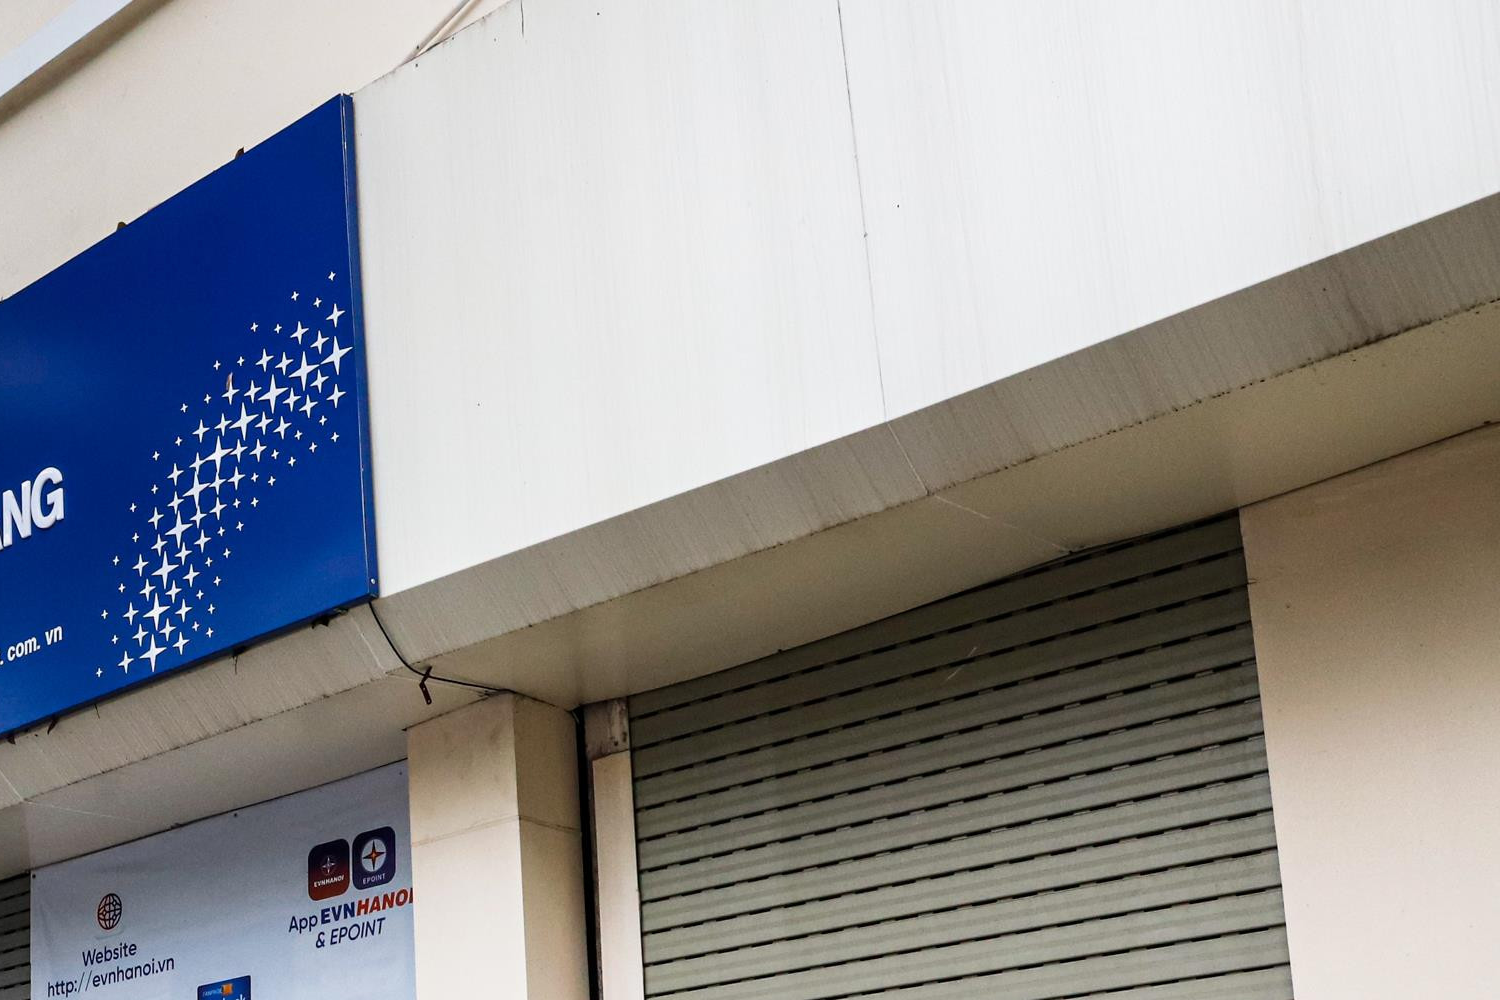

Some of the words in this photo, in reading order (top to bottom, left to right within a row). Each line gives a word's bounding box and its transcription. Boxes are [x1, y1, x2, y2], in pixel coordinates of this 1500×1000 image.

[313, 874, 345, 888] EVNHANOI
[362, 873, 386, 885] EPOINT
[288, 914, 318, 934] App
[315, 931, 326, 949] &
[330, 917, 386, 945] EPOINT
[81, 940, 138, 967] Website
[47, 956, 175, 998] http://evnhanoi.vn
